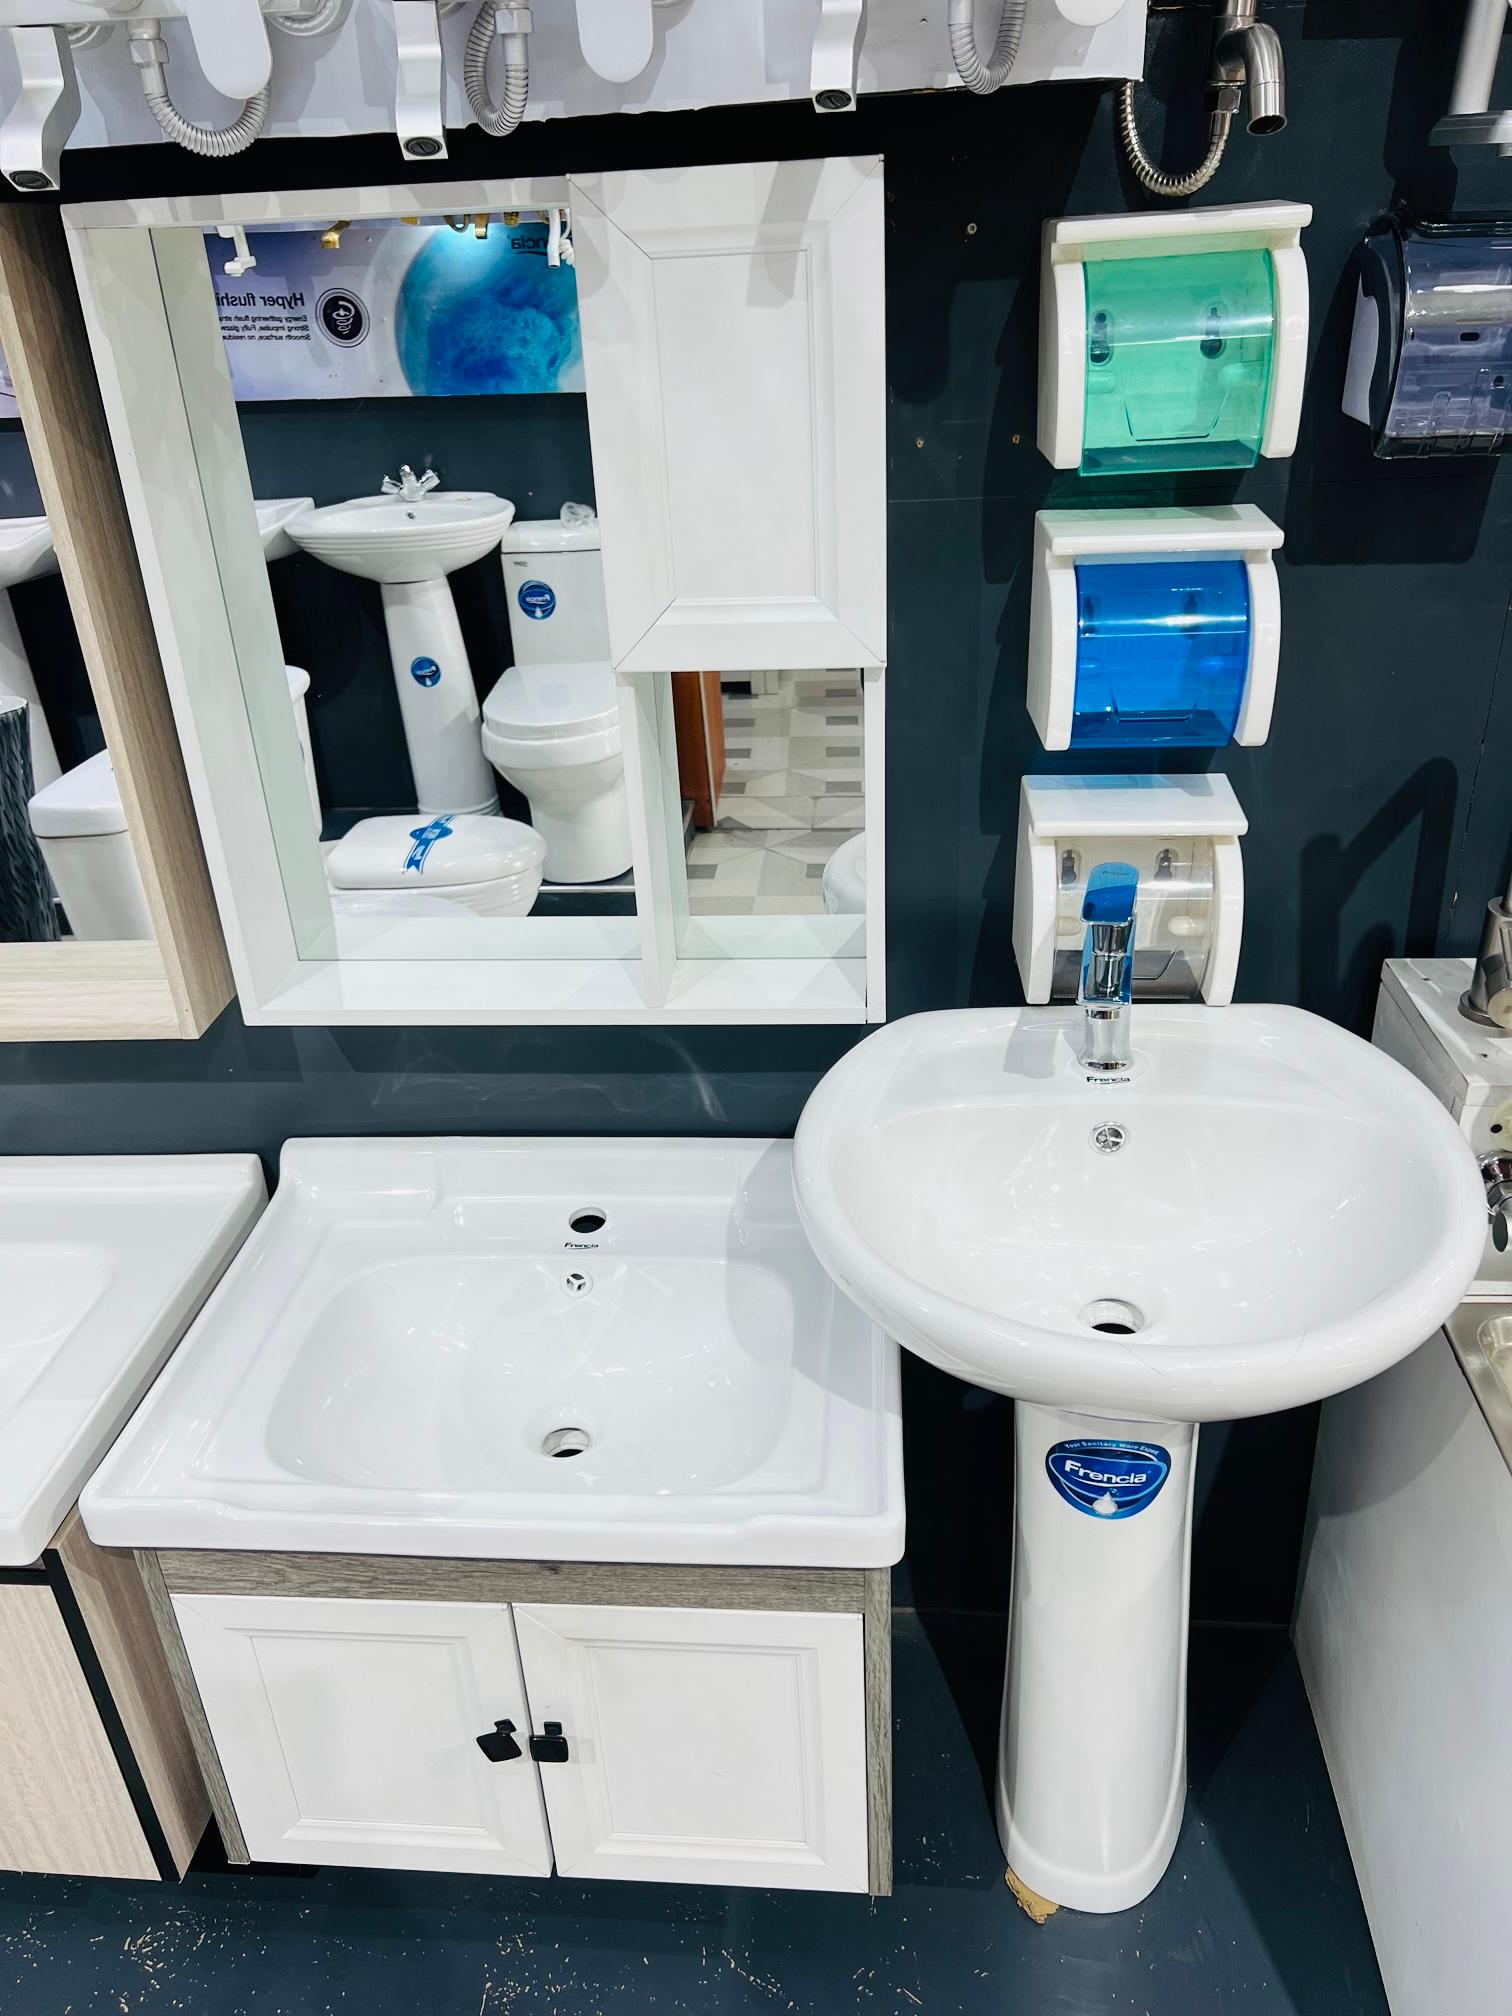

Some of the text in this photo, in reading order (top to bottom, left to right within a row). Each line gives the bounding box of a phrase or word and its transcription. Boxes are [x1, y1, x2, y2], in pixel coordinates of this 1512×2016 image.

[1064, 1441, 1081, 1449] Your
[1119, 1442, 1138, 1450] Ware
[1064, 1459, 1147, 1484] Frencia
